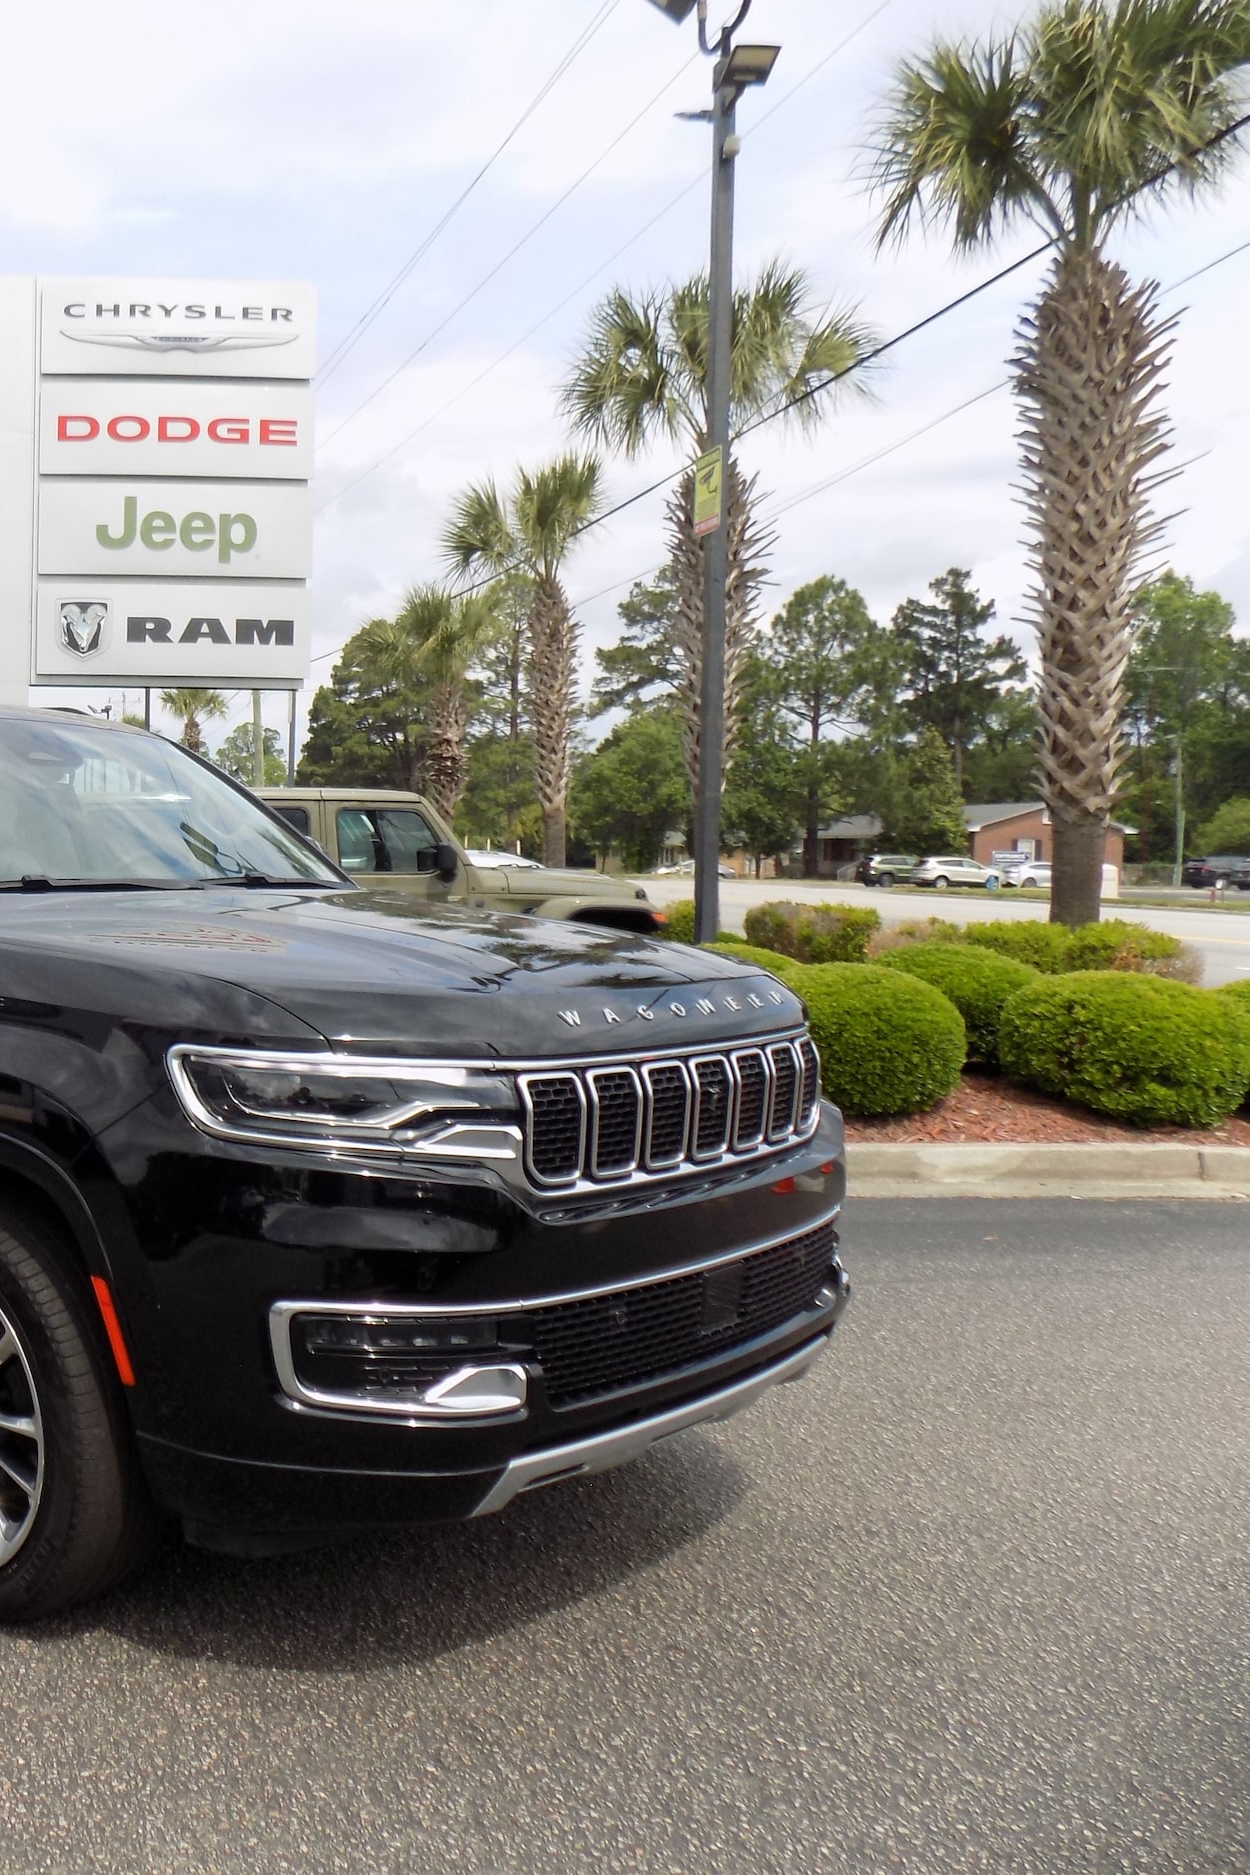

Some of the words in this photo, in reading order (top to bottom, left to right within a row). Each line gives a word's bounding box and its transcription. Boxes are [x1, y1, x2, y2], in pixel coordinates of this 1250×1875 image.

[63, 304, 293, 322] CHRYSLER
[57, 415, 298, 446] DODGE
[95, 496, 258, 563] Jeep
[126, 616, 295, 645] RAM
[557, 991, 784, 1028] WAGONEER
